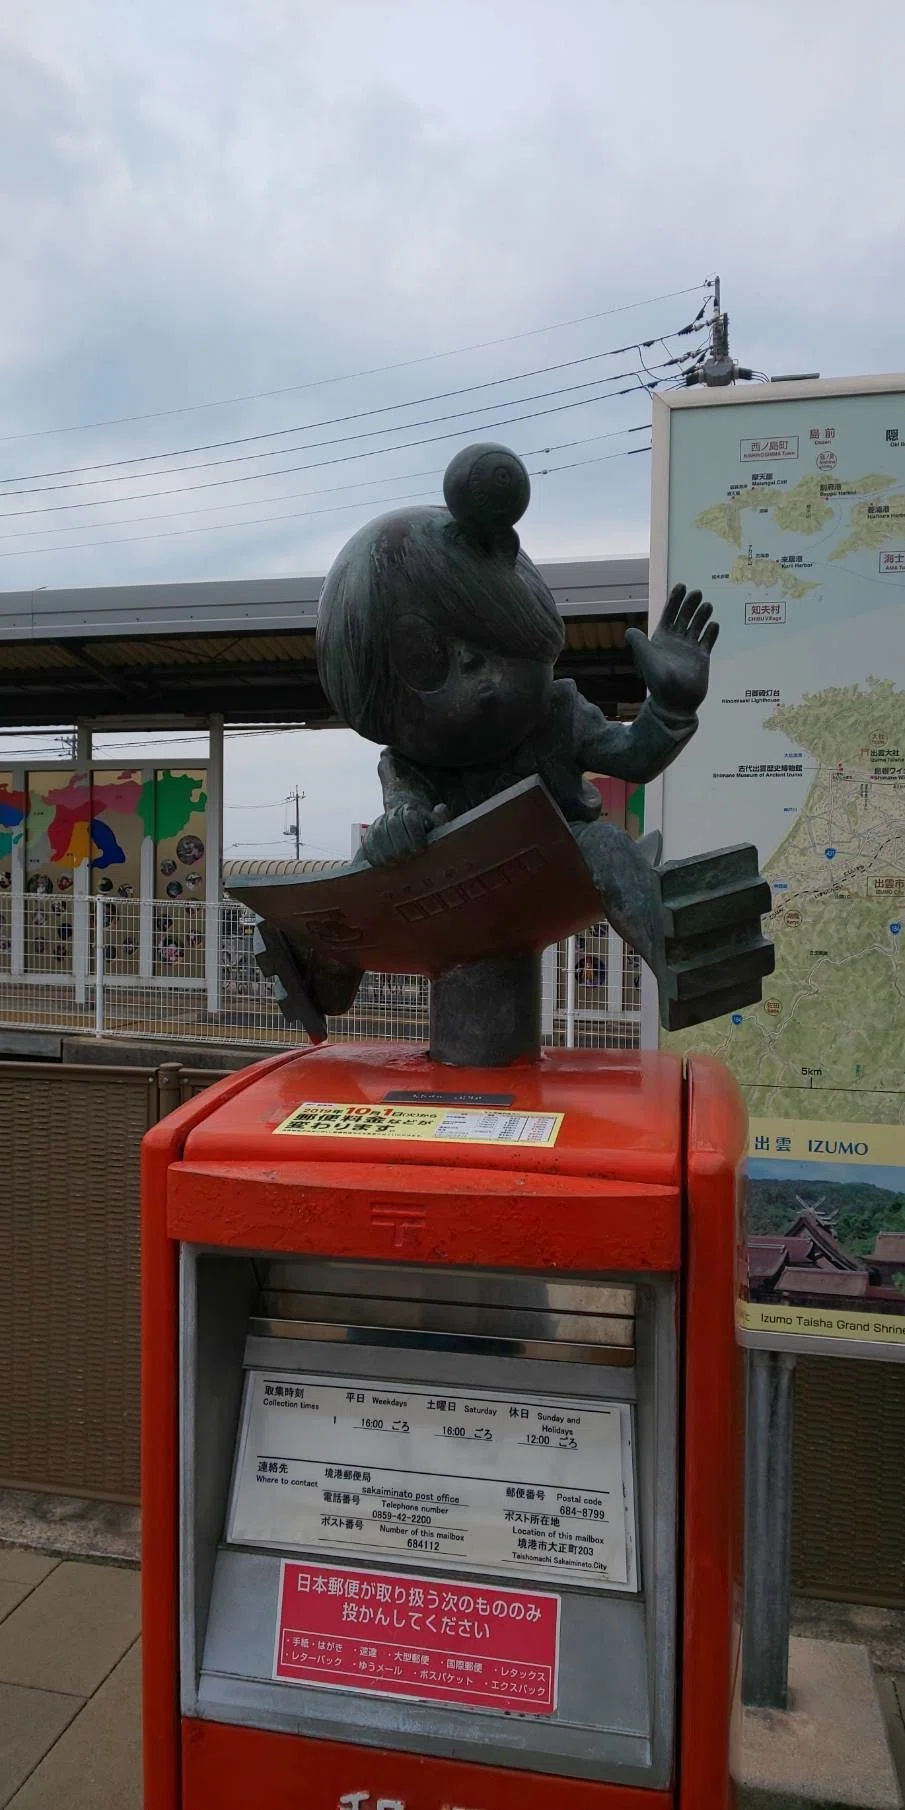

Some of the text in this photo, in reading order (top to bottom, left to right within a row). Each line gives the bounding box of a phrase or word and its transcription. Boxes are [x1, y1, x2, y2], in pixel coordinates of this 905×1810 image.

[751, 440, 788, 452] 西ノ島町
[751, 605, 781, 615] 知夫村
[801, 1067, 823, 1076] 5km
[292, 1113, 435, 1126] 郵便料金などが
[755, 1136, 792, 1152] 出雲
[808, 1140, 869, 1156] IZUMO
[761, 1313, 793, 1325] Izumo
[796, 1316, 833, 1329] Taisha
[836, 1320, 870, 1332] Grand
[264, 1385, 305, 1399] 取集時刻
[345, 1392, 365, 1404] 平日
[263, 1398, 320, 1411] Collection times
[372, 1396, 408, 1408] Weekdays
[426, 1400, 456, 1412] 土曜日
[464, 1405, 497, 1417] Saturday
[509, 1407, 529, 1419] 休日
[361, 1418, 384, 1429] 16:00
[537, 1413, 581, 1425] Sunday and
[391, 1421, 410, 1432] ごろ
[542, 1425, 574, 1436] Holidays
[474, 1428, 493, 1440] ごろ
[526, 1434, 550, 1445] 12:00
[558, 1438, 578, 1449] ごろ
[258, 1461, 289, 1474] 連絡先
[256, 1475, 319, 1488] Where to contact
[325, 1468, 372, 1483] 境港郵便局
[323, 1491, 361, 1506] 電話番号
[361, 1486, 460, 1504] sakaiminato post office
[506, 1487, 546, 1501] 郵便番号
[557, 1493, 603, 1506] Postal code
[381, 1499, 449, 1514] Telephone number
[559, 1505, 605, 1520] 684-8799
[321, 1516, 364, 1530] ポスト番号
[372, 1510, 432, 1524] 0859-42-2200
[504, 1511, 560, 1527] ポスト所在地
[379, 1523, 465, 1542] Number of this mailbox
[512, 1526, 605, 1544] Location of this mailbox
[407, 1538, 440, 1551] 684112
[517, 1538, 594, 1556] 境港市大正町203
[512, 1552, 552, 1564] Taishomachi
[593, 1561, 607, 1571] City
[297, 1573, 542, 1623] 日本郵便が取り扱う次のもののみ
[342, 1602, 490, 1639] 投かんしてください
